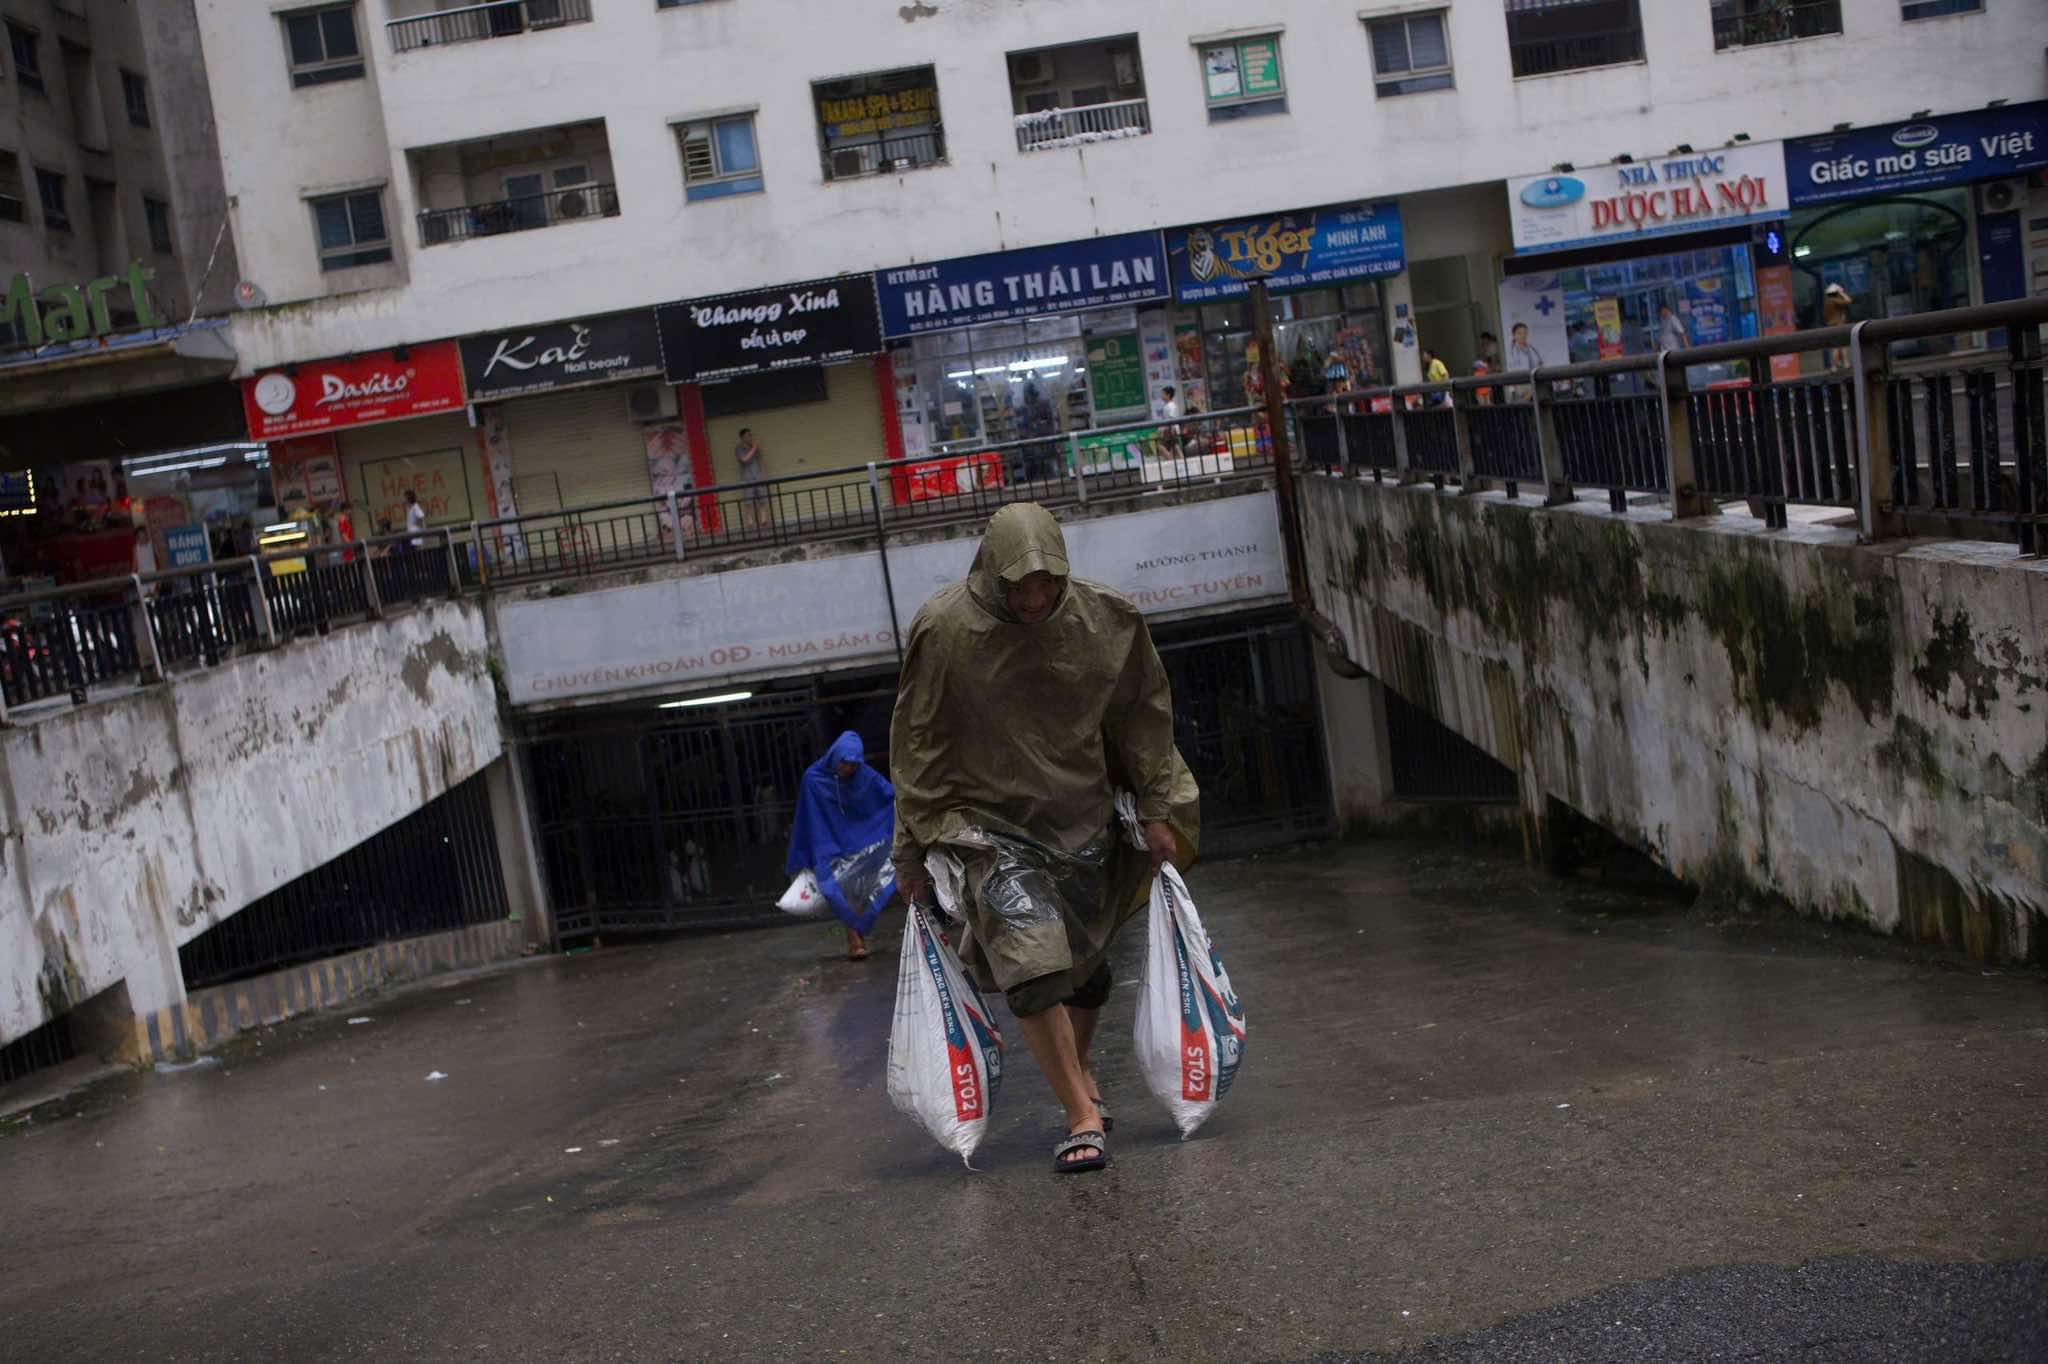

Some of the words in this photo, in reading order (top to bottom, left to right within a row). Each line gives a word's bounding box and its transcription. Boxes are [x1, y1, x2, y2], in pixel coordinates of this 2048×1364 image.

[1810, 154, 1868, 184] Giấc
[1875, 150, 1917, 175] mơ
[1925, 143, 1972, 166] sữa
[1980, 131, 2035, 159] Việt
[1618, 162, 1657, 188] NHÀ
[1590, 187, 1667, 232] DƯỢC
[1669, 176, 1712, 217] HÀ
[1715, 173, 1768, 213] NỘI
[1220, 221, 1316, 272] Tiger
[1327, 228, 1358, 249] MINH
[1361, 224, 1387, 242] ANH
[887, 266, 939, 285] HTMart
[904, 279, 995, 317] HÀNG
[1004, 265, 1082, 302] THÁI
[1091, 256, 1156, 289] LAN
[697, 303, 783, 328] Changg
[788, 288, 840, 315] Xinh
[564, 361, 587, 374] Nail
[589, 354, 630, 371] beauty
[168, 530, 204, 550] BÁNH
[1199, 543, 1258, 561] THANH
[768, 641, 819, 657] MUA
